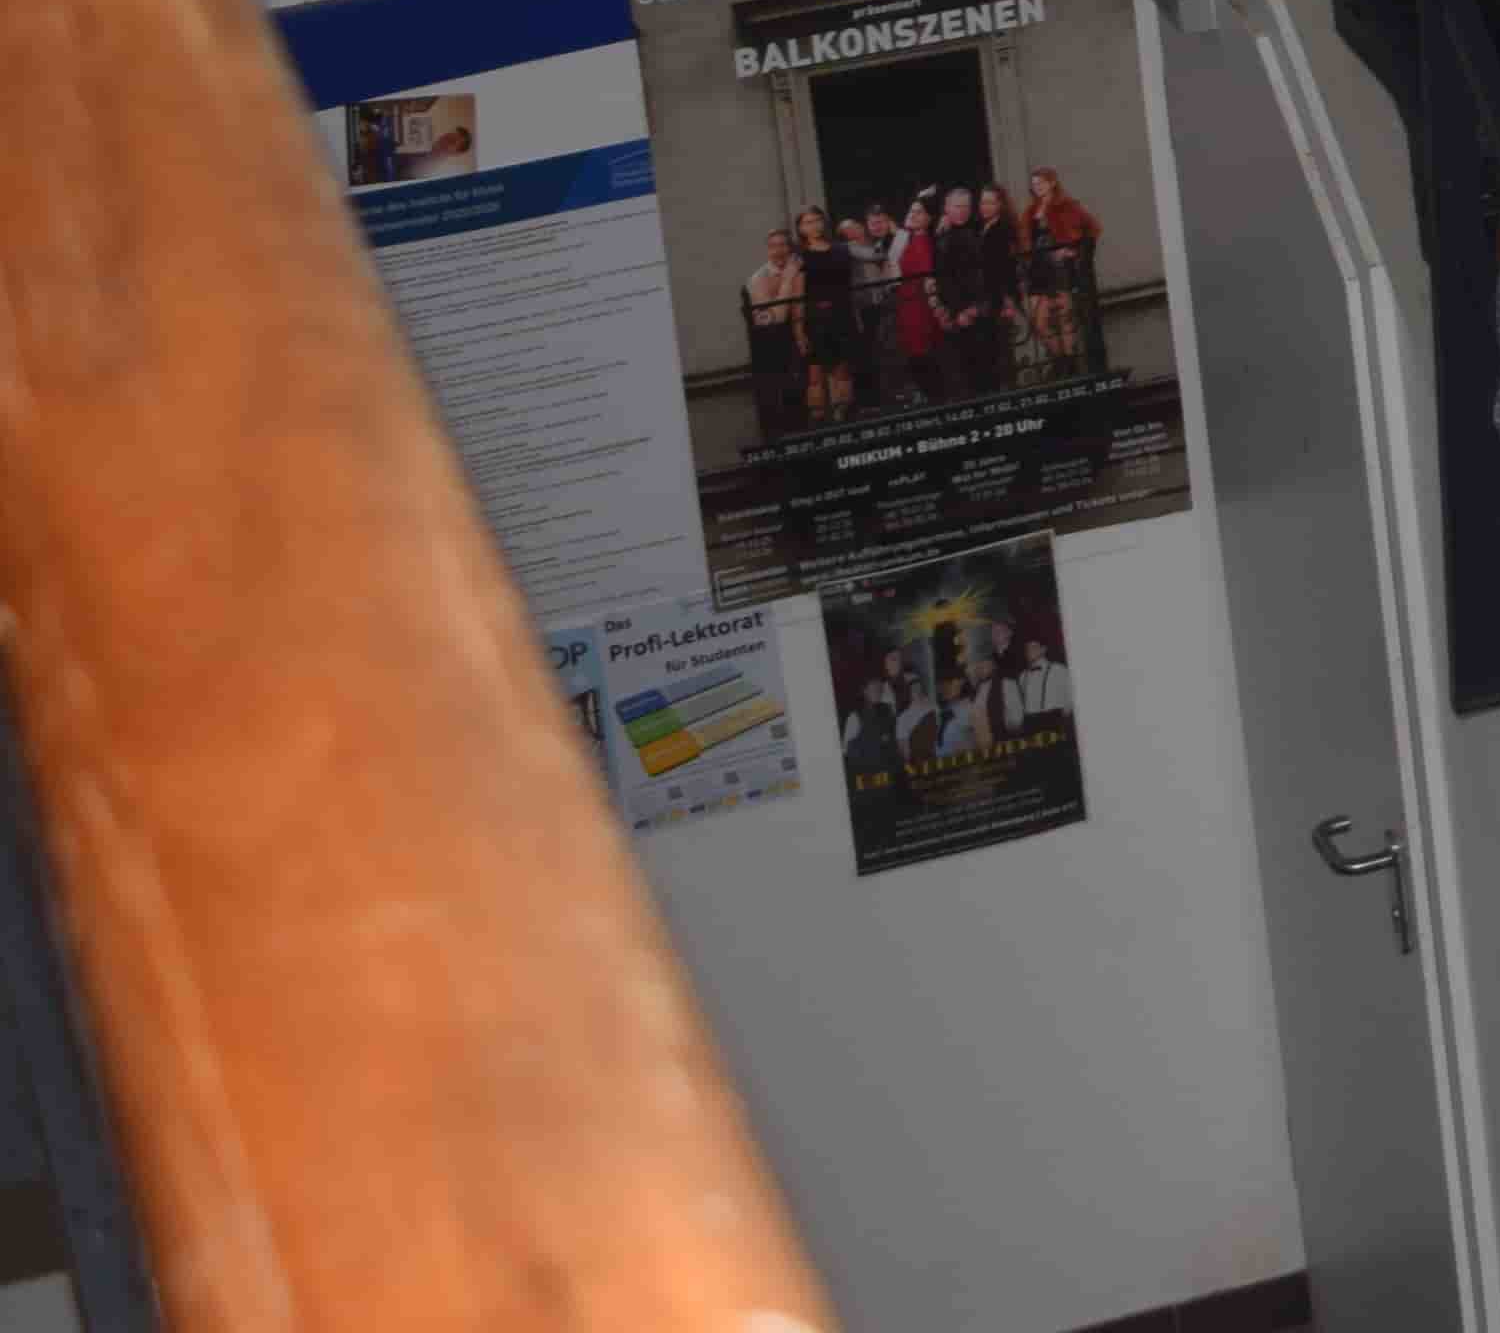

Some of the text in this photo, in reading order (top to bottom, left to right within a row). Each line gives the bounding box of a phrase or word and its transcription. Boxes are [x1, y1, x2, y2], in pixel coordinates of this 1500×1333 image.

[837, 445, 903, 470] UNIKUM
[969, 428, 980, 445] 2
[1016, 416, 1046, 434] Uhr
[605, 617, 632, 634] Das
[608, 610, 765, 663] Profi-Lektorat
[666, 639, 768, 674] für Studenten
